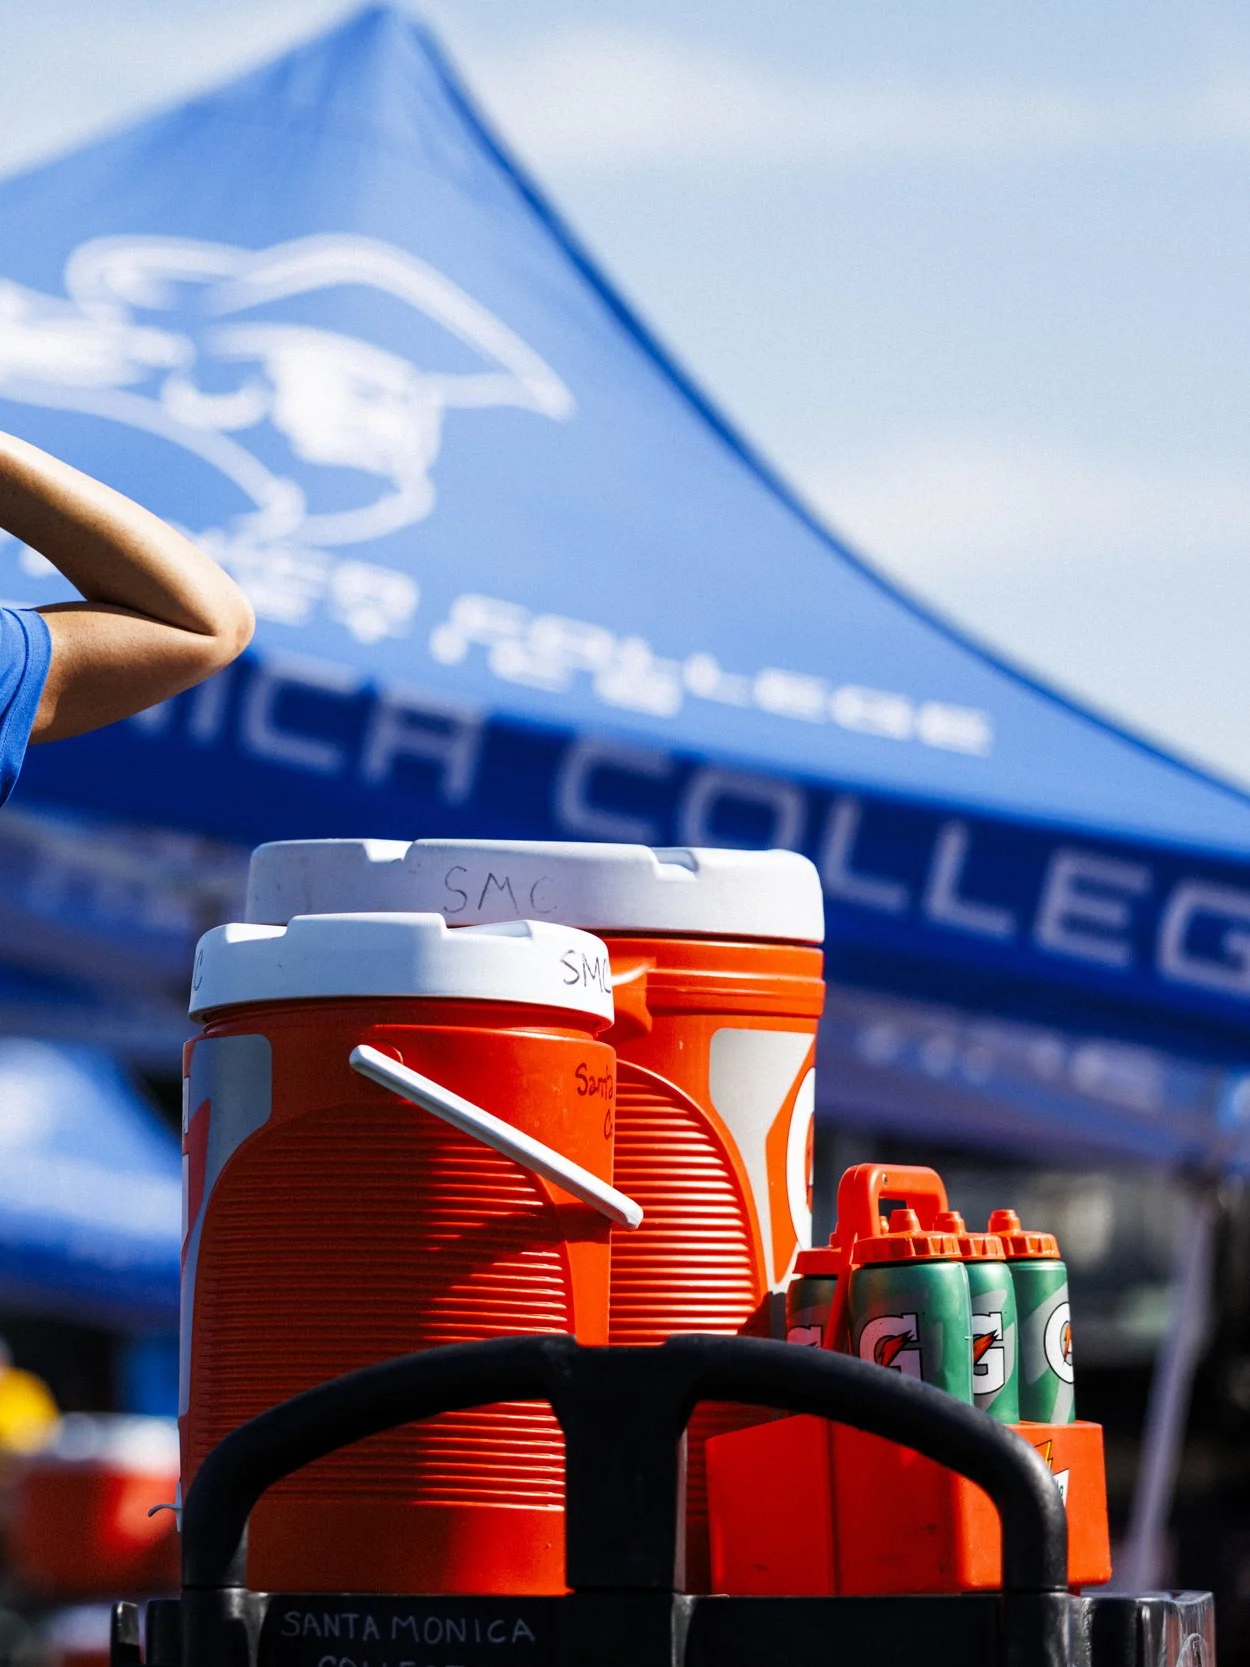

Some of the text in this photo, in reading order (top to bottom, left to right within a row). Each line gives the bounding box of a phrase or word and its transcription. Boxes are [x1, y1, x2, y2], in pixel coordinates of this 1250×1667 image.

[443, 865, 556, 915] SMC
[280, 1611, 536, 1644] SANTA MONICA
